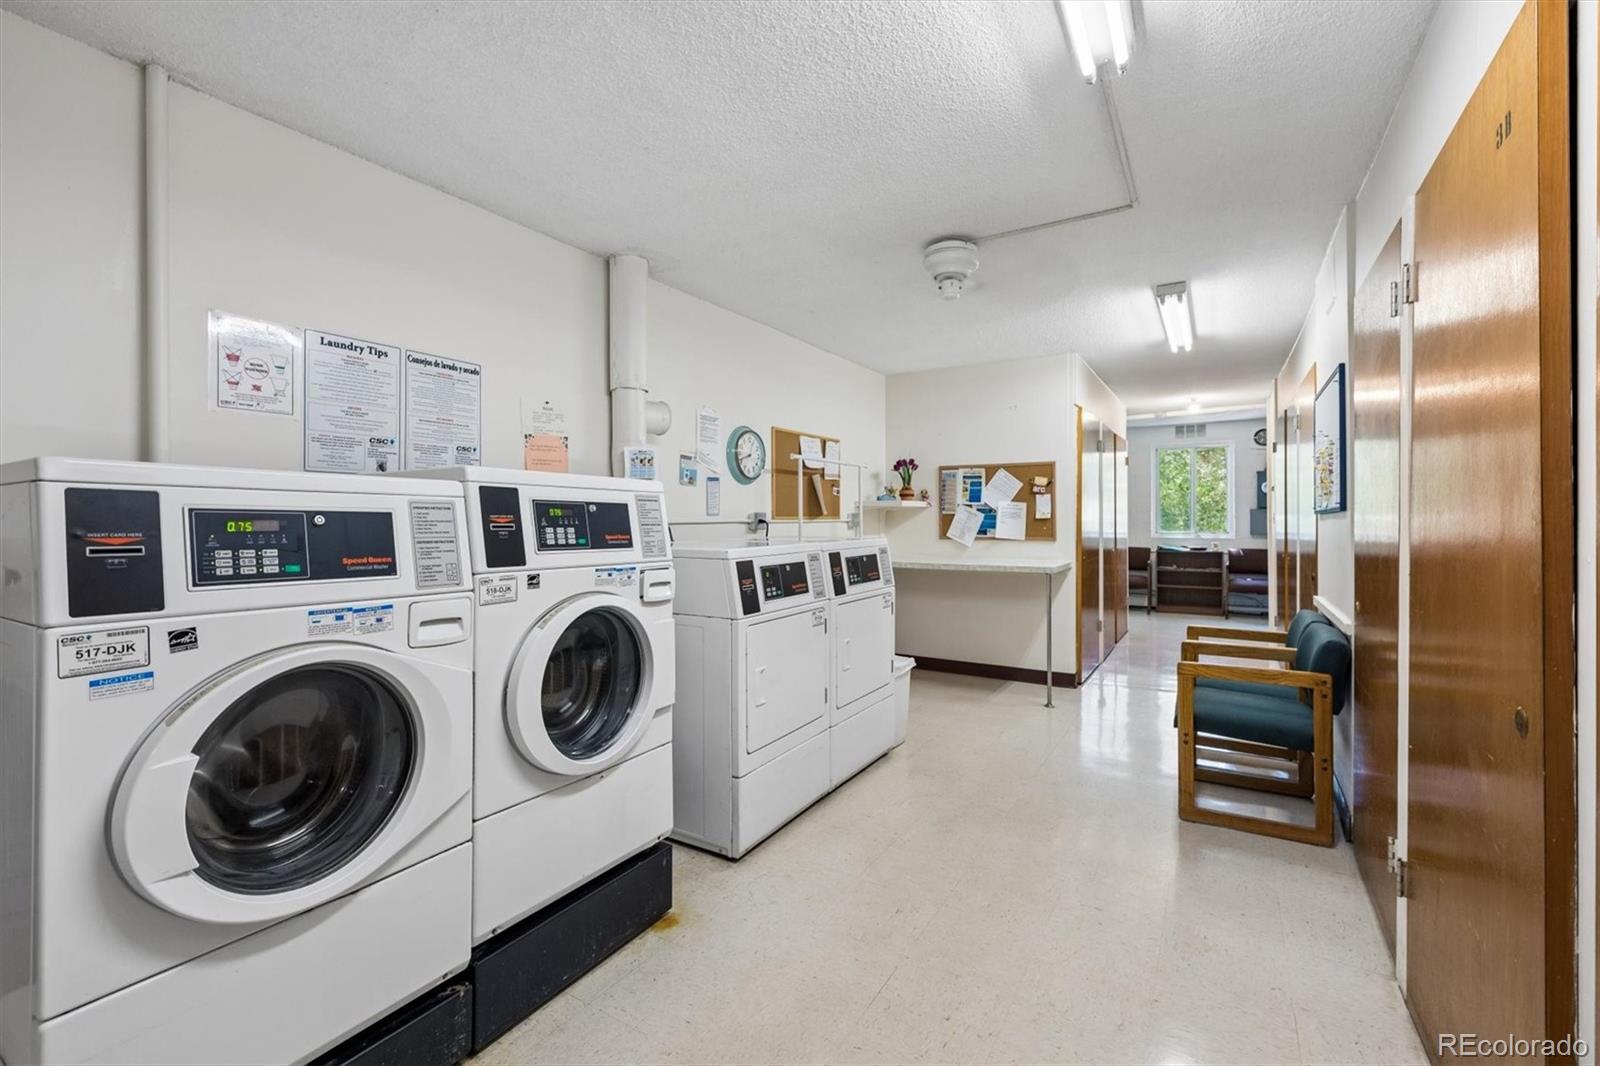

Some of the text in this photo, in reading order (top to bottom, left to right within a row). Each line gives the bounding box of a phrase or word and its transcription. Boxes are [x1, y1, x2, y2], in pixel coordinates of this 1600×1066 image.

[320, 336, 364, 355] Laundry
[367, 345, 388, 358] Tips
[407, 354, 432, 367] Consejos
[434, 360, 440, 368] de
[441, 361, 458, 371] lavado
[369, 437, 389, 445] CSC
[75, 643, 136, 659] 517-DJK
[99, 674, 142, 686] NOTICE
